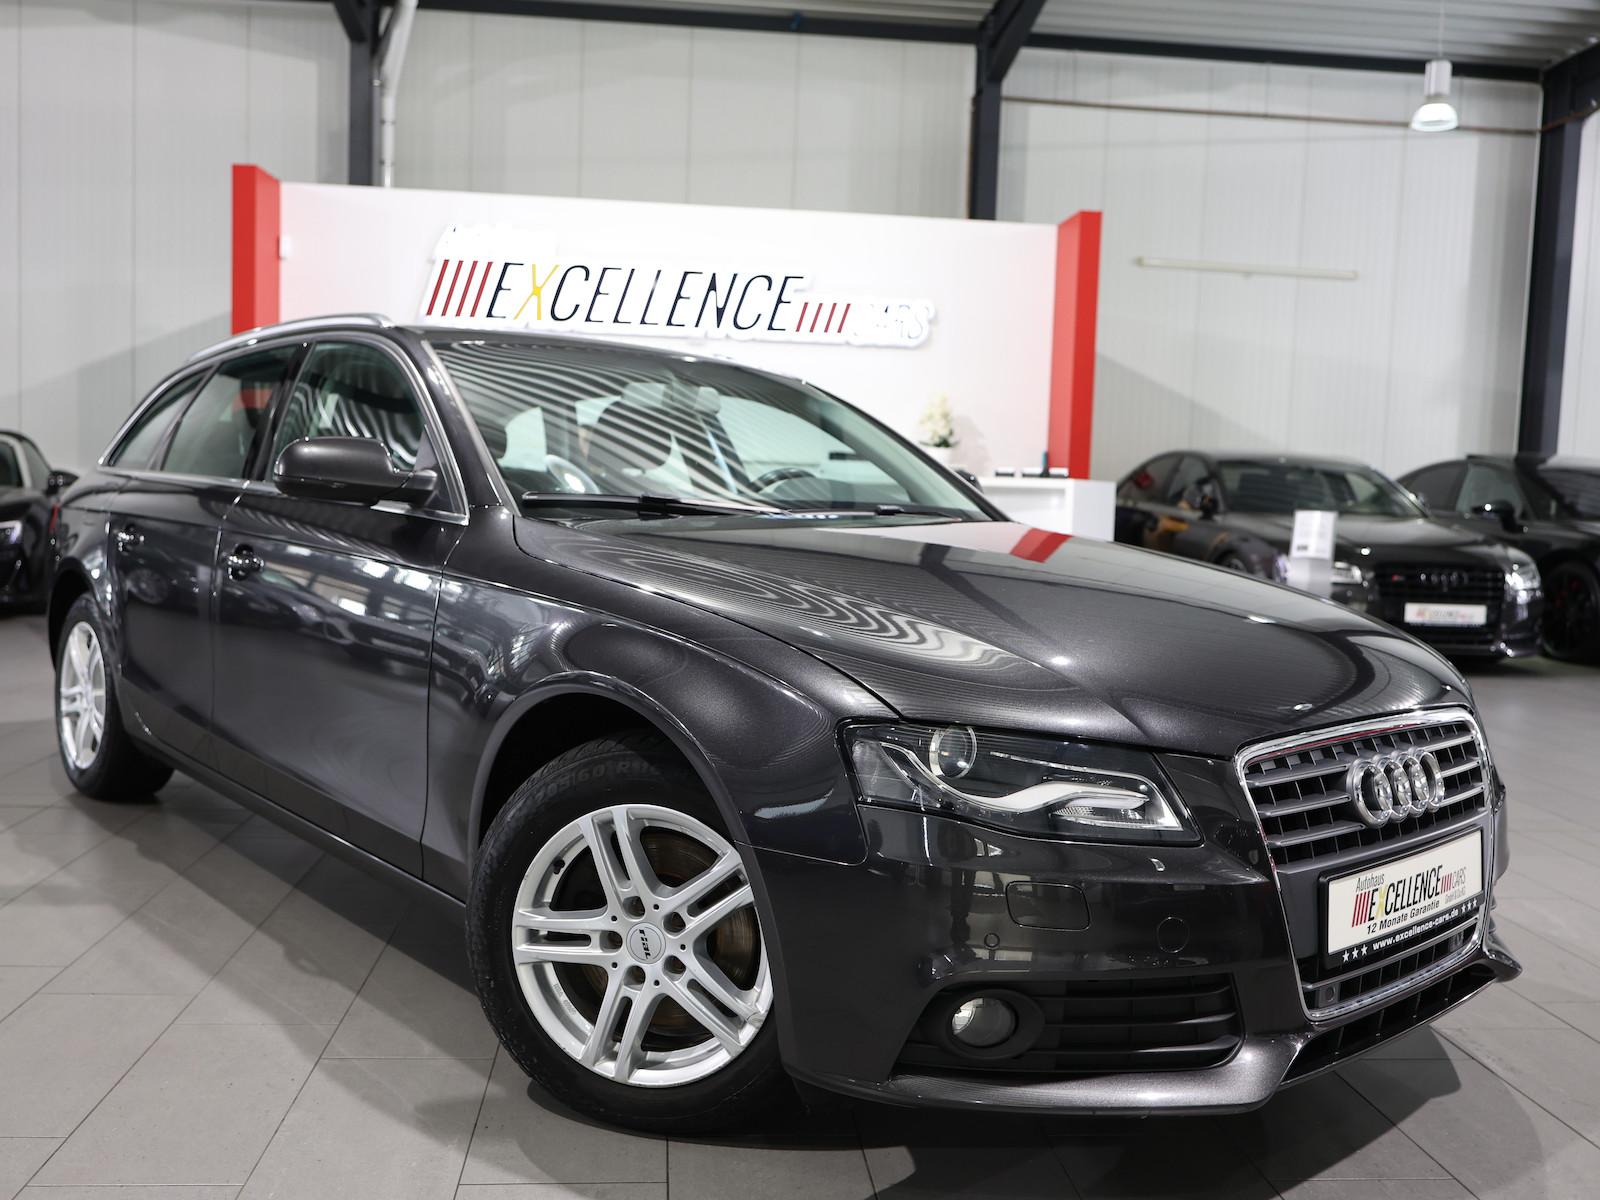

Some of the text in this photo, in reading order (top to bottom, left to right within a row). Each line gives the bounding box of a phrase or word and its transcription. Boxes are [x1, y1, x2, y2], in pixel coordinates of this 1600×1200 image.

[485, 261, 805, 332] EXCELLENCE
[1356, 873, 1385, 892] Autohaus
[1367, 864, 1443, 922] EXCELLENCE
[1367, 900, 1440, 935] 12 Monate Garantie
[1372, 908, 1459, 951] www.excellence-cars.de
